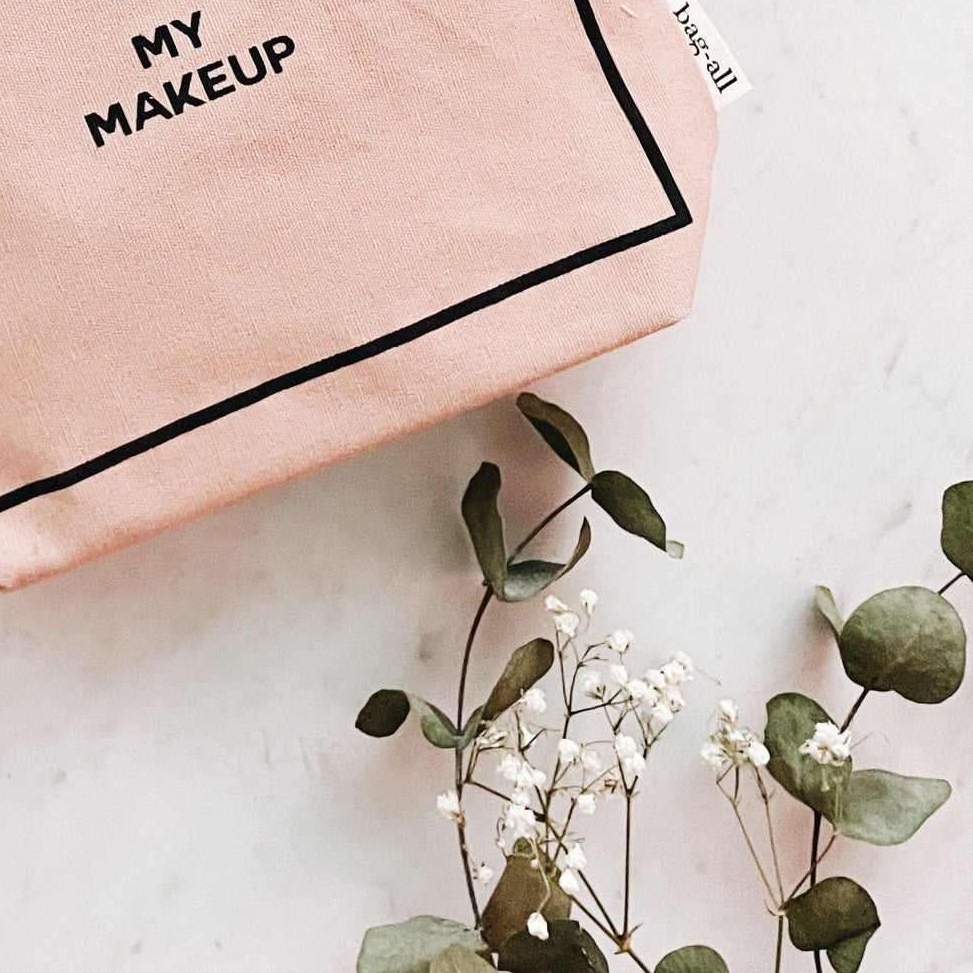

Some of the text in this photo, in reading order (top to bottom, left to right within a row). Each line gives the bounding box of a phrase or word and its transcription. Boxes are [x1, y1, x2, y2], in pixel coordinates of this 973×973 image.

[131, 10, 202, 69] MY
[673, 1, 738, 94] bag-all
[84, 35, 295, 148] MAKEUP
